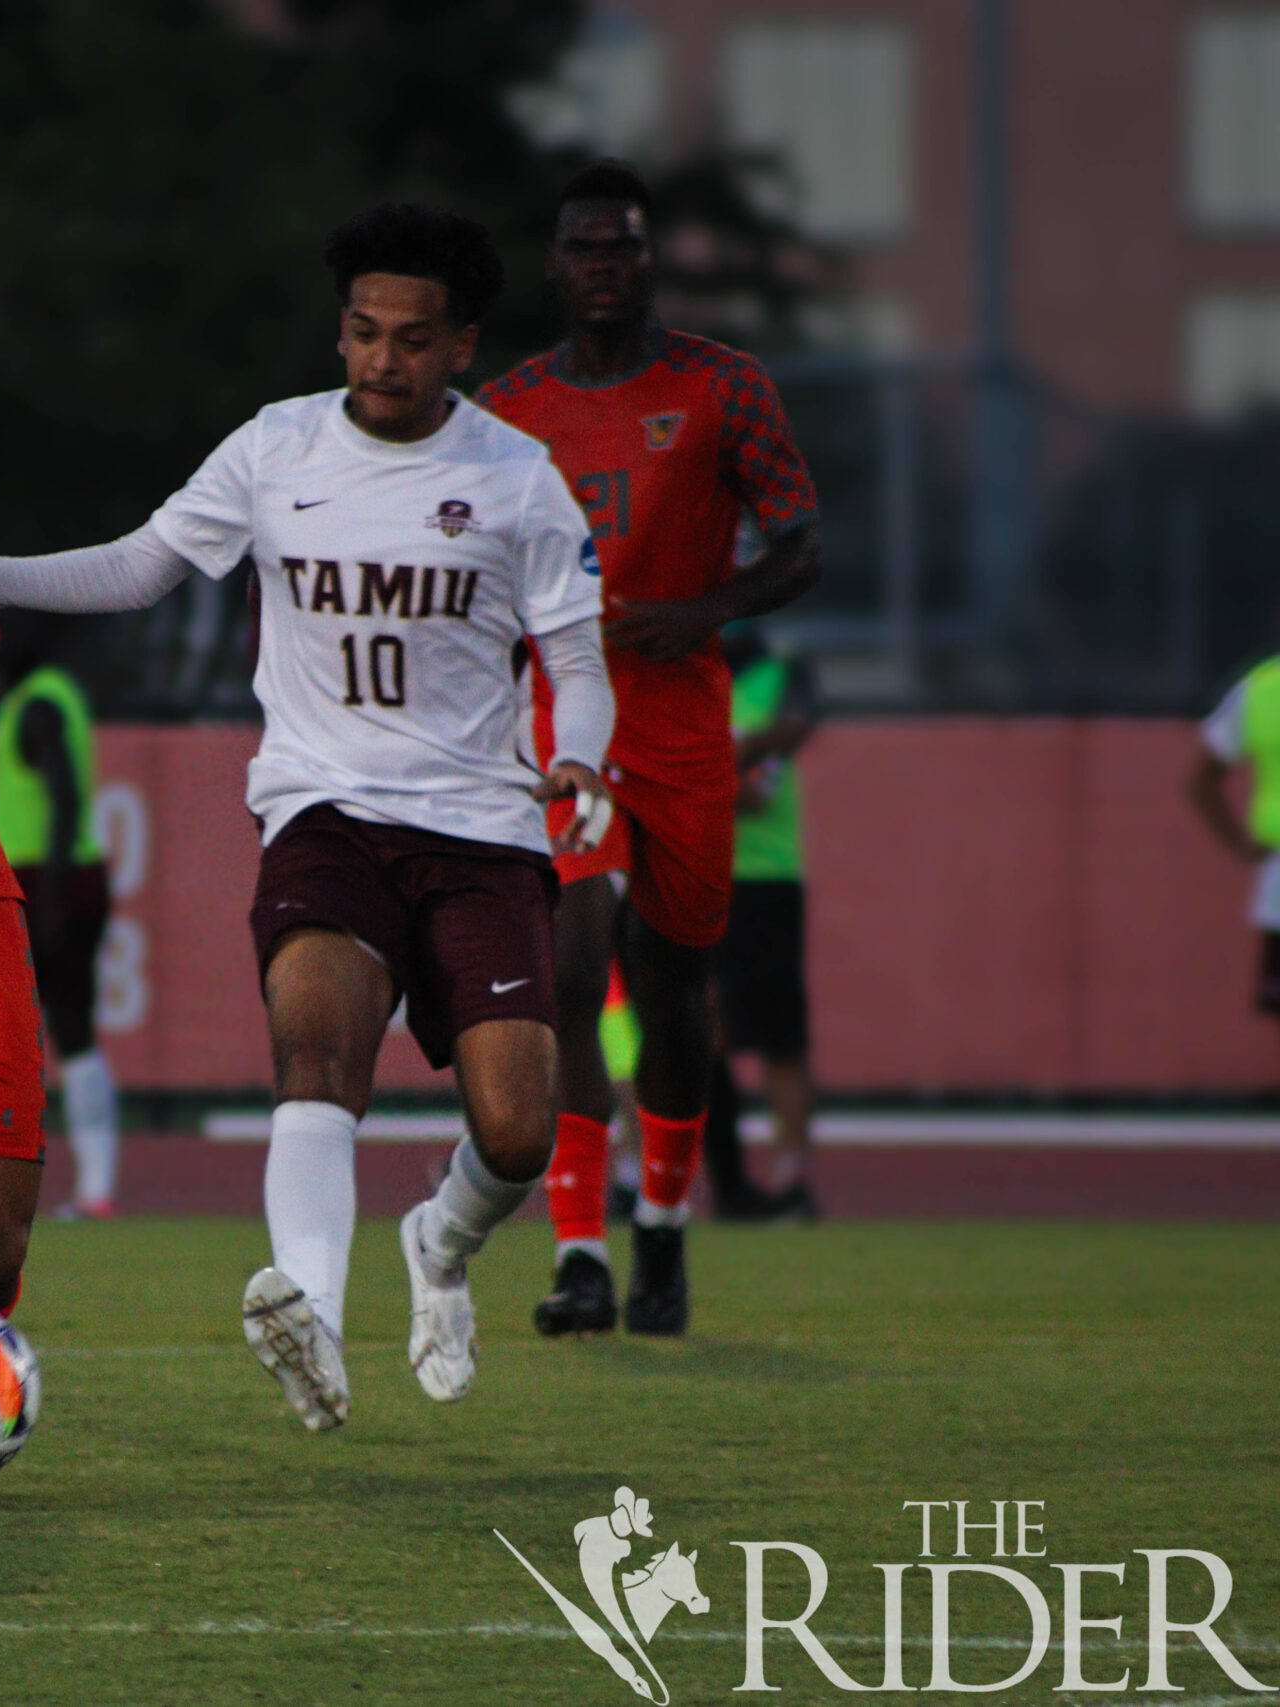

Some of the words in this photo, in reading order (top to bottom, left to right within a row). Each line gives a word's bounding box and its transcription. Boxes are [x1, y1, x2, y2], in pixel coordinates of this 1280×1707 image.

[577, 469, 630, 539] 21
[281, 556, 479, 620] TAMIU
[341, 633, 406, 708] 10
